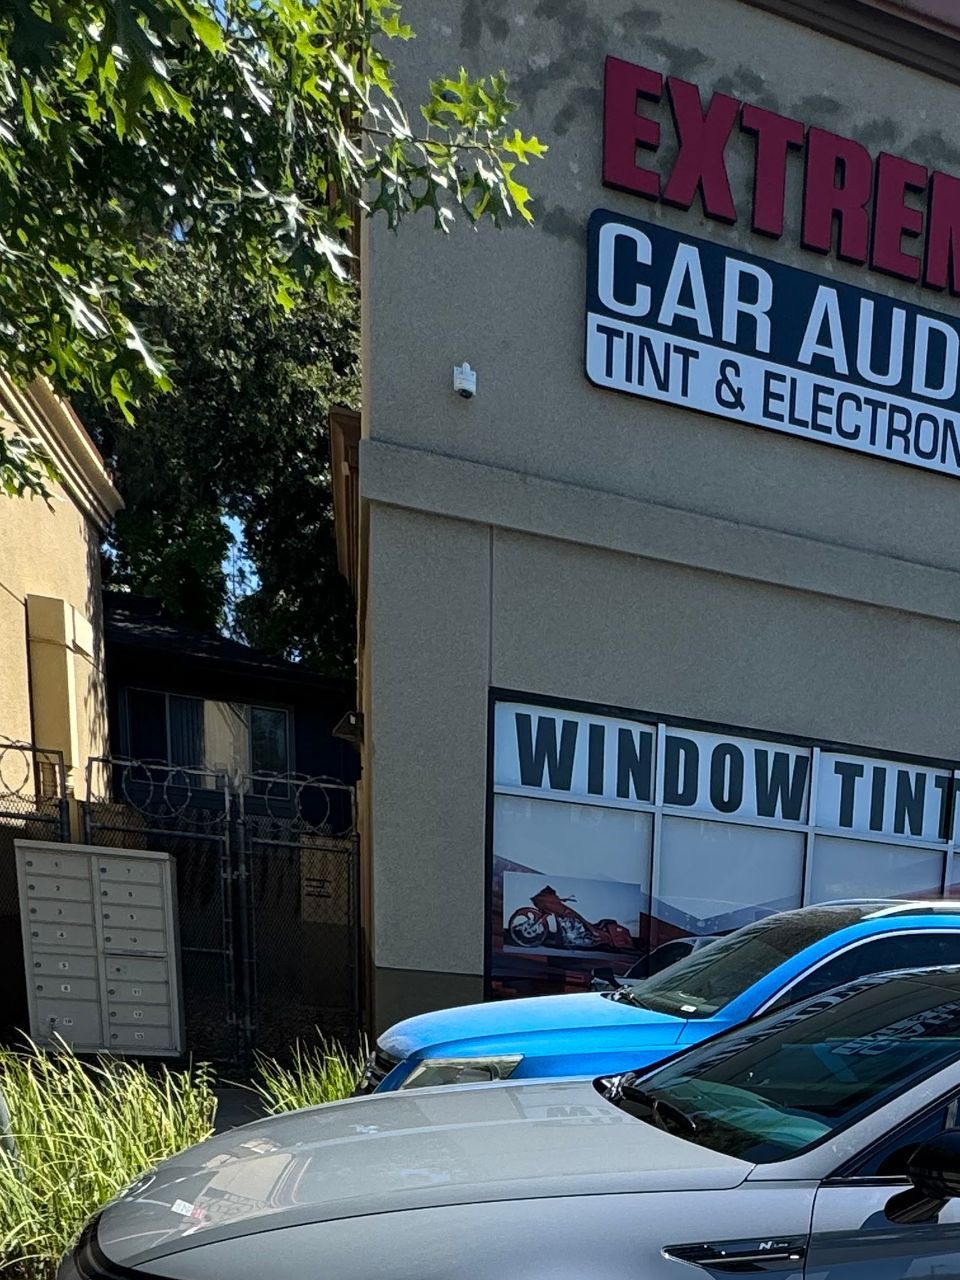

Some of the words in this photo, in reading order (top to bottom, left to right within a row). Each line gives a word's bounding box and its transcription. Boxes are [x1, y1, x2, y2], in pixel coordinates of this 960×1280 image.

[597, 222, 774, 354] CAR
[596, 323, 700, 397] TINT
[715, 359, 746, 412] &
[515, 713, 810, 822] WINDOW
[759, 1241, 772, 1250] N
